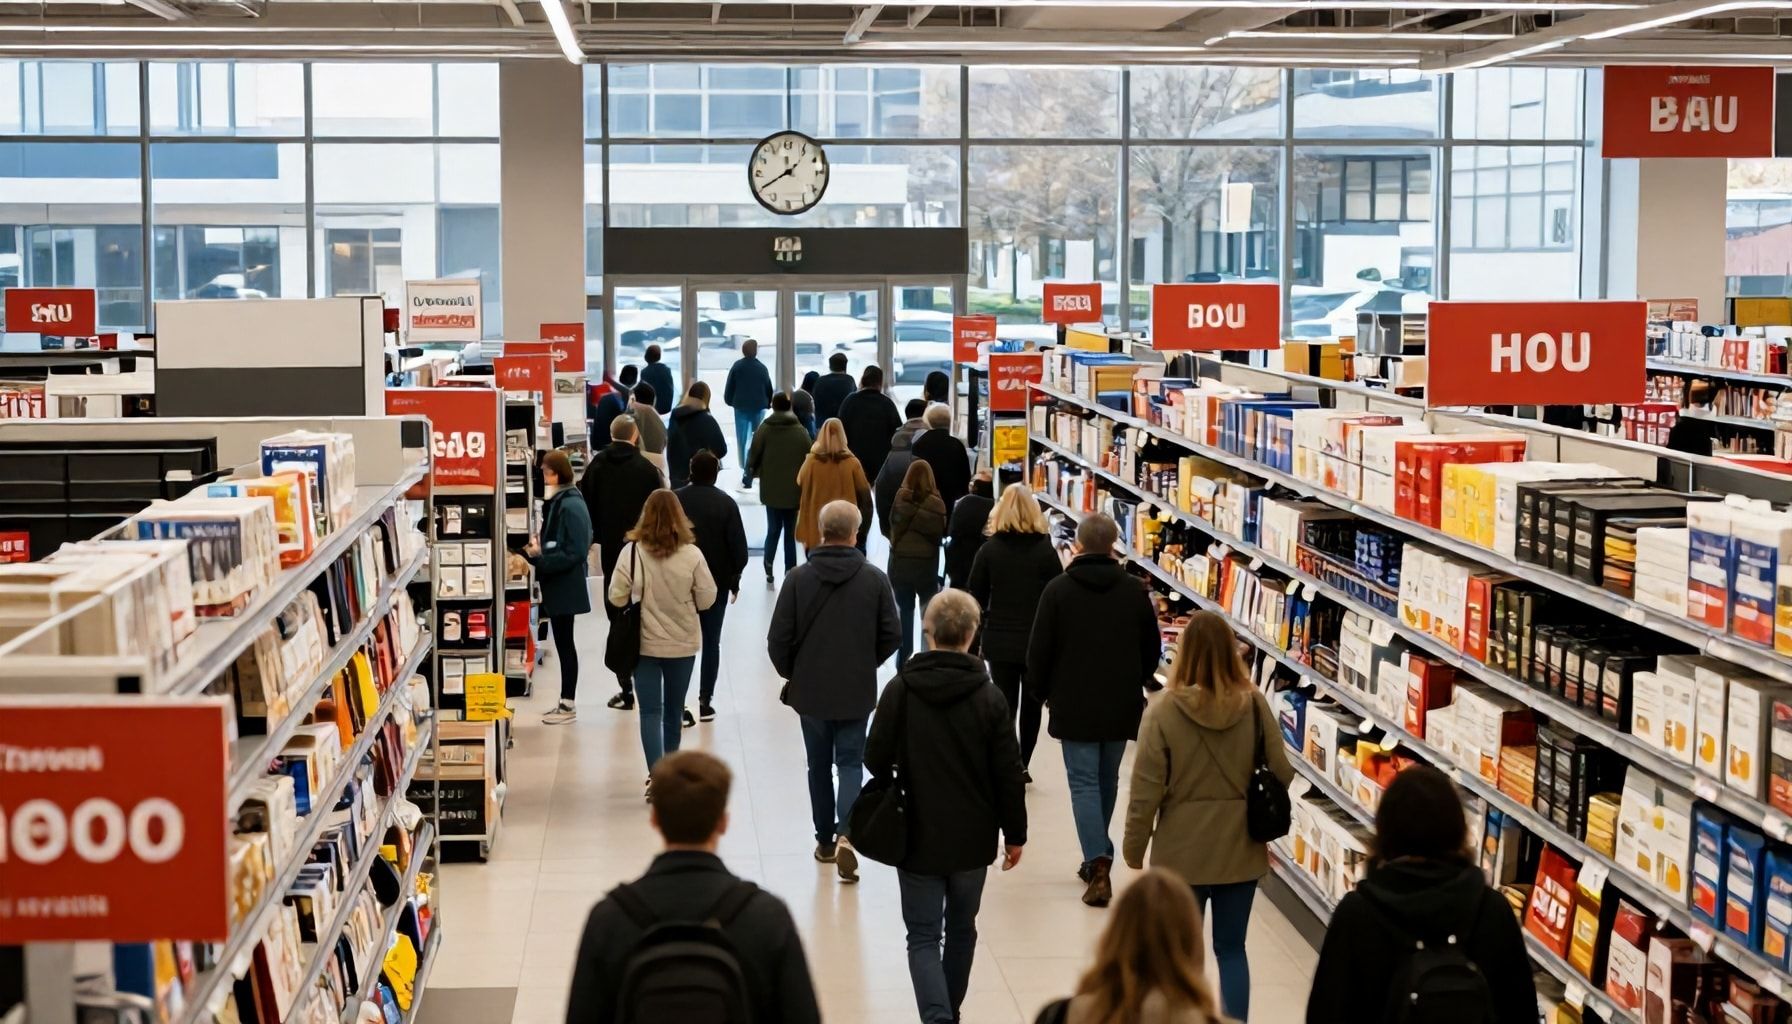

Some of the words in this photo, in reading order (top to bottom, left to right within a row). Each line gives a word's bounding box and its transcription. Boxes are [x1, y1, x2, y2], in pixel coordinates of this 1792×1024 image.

[1650, 95, 1738, 133] BAU
[1187, 303, 1246, 329] BOU
[1491, 332, 1591, 373] HOU
